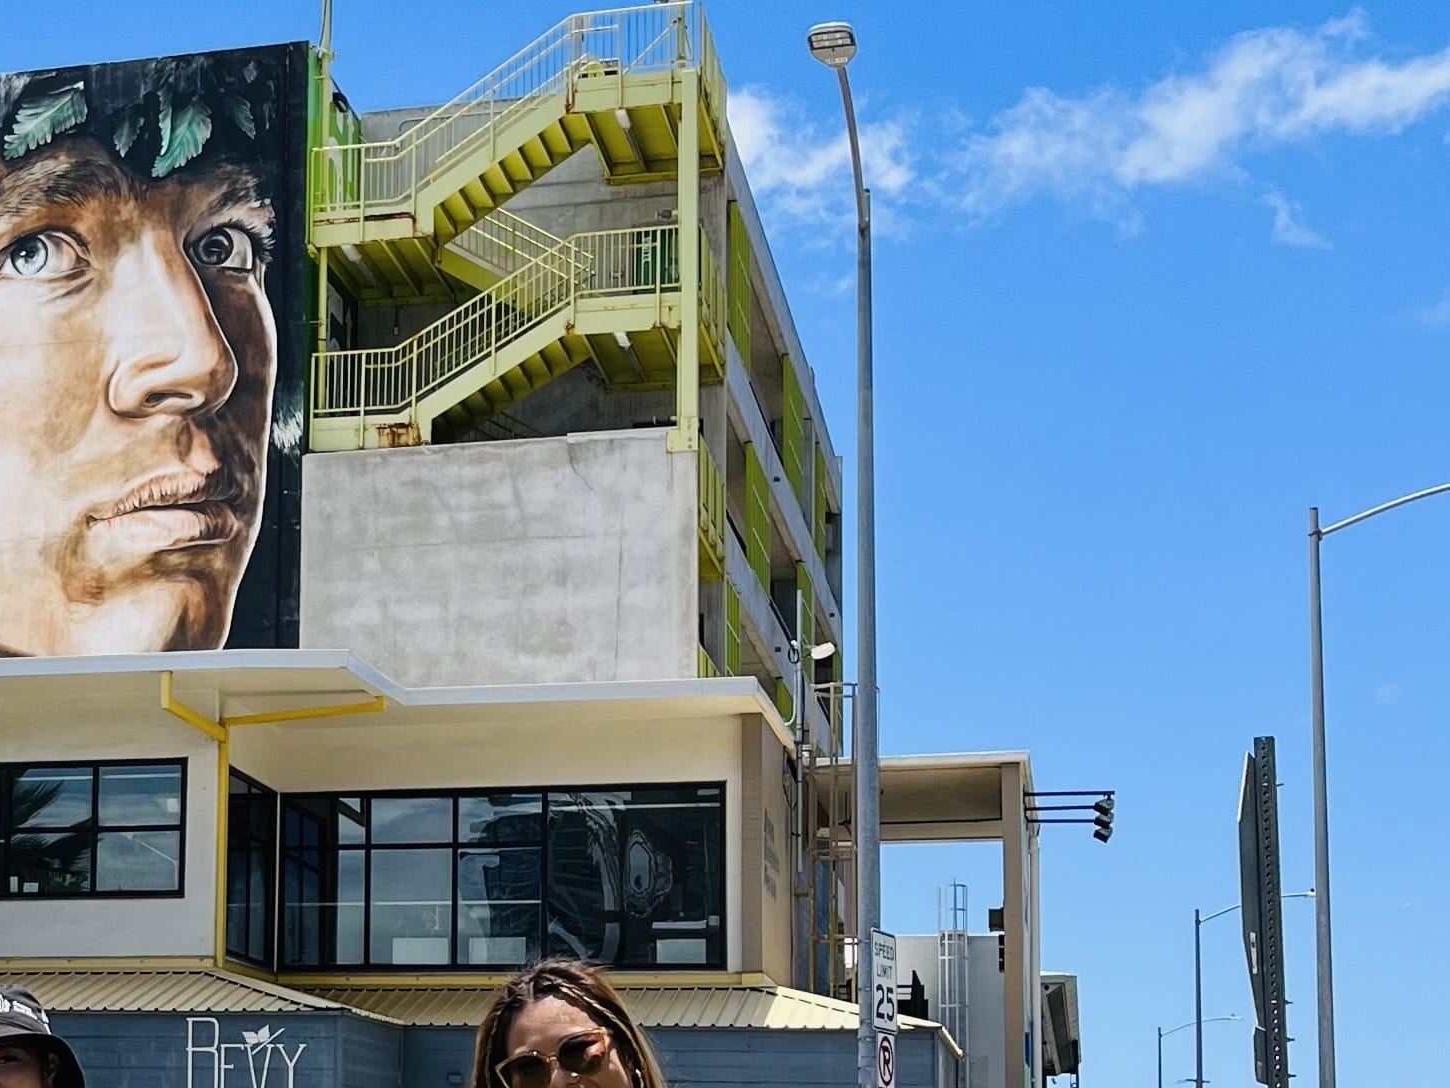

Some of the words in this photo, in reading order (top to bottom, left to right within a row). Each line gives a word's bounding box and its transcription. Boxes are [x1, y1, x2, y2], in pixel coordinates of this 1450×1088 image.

[875, 942, 894, 961] SPEED
[877, 962, 892, 979] LIMIT
[876, 984, 894, 1021] 25
